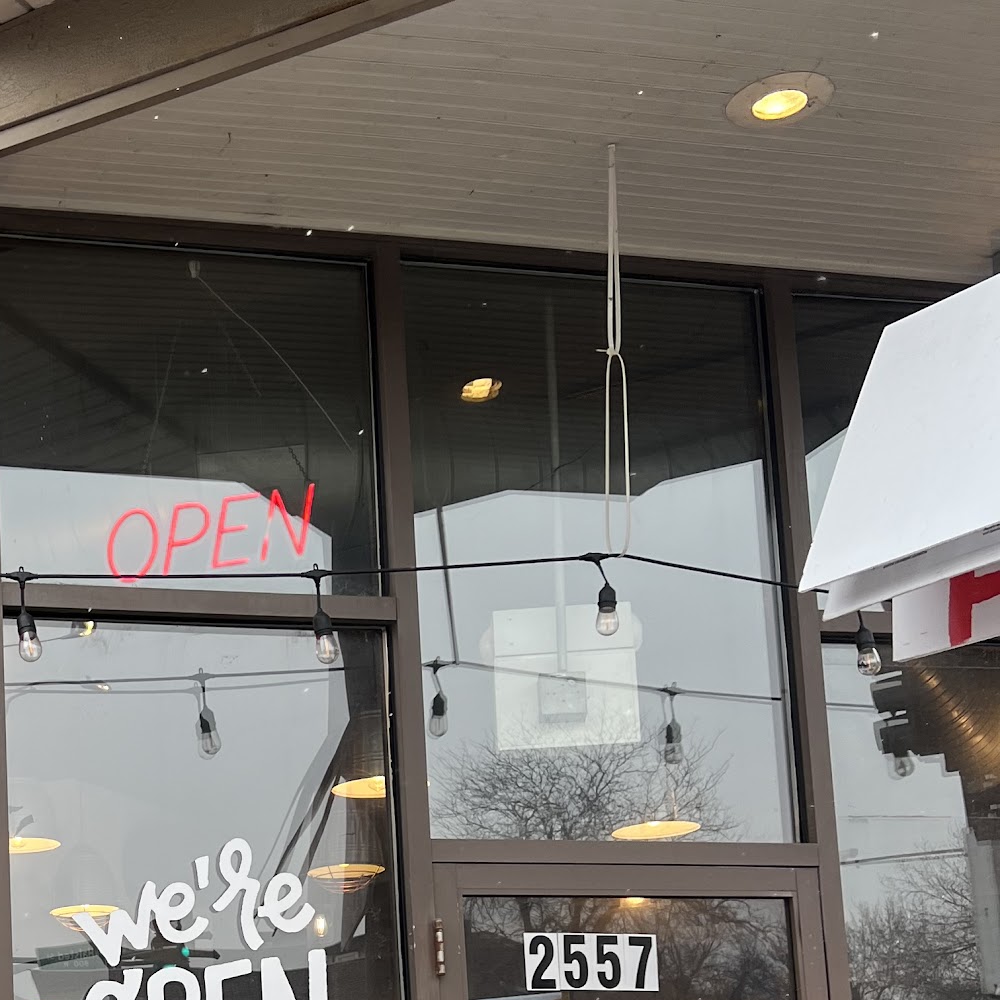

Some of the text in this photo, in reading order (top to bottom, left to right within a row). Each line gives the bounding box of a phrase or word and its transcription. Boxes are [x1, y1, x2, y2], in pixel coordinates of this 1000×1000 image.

[107, 483, 315, 584] OPEN
[72, 838, 315, 967] we're
[529, 935, 652, 989] 2557
